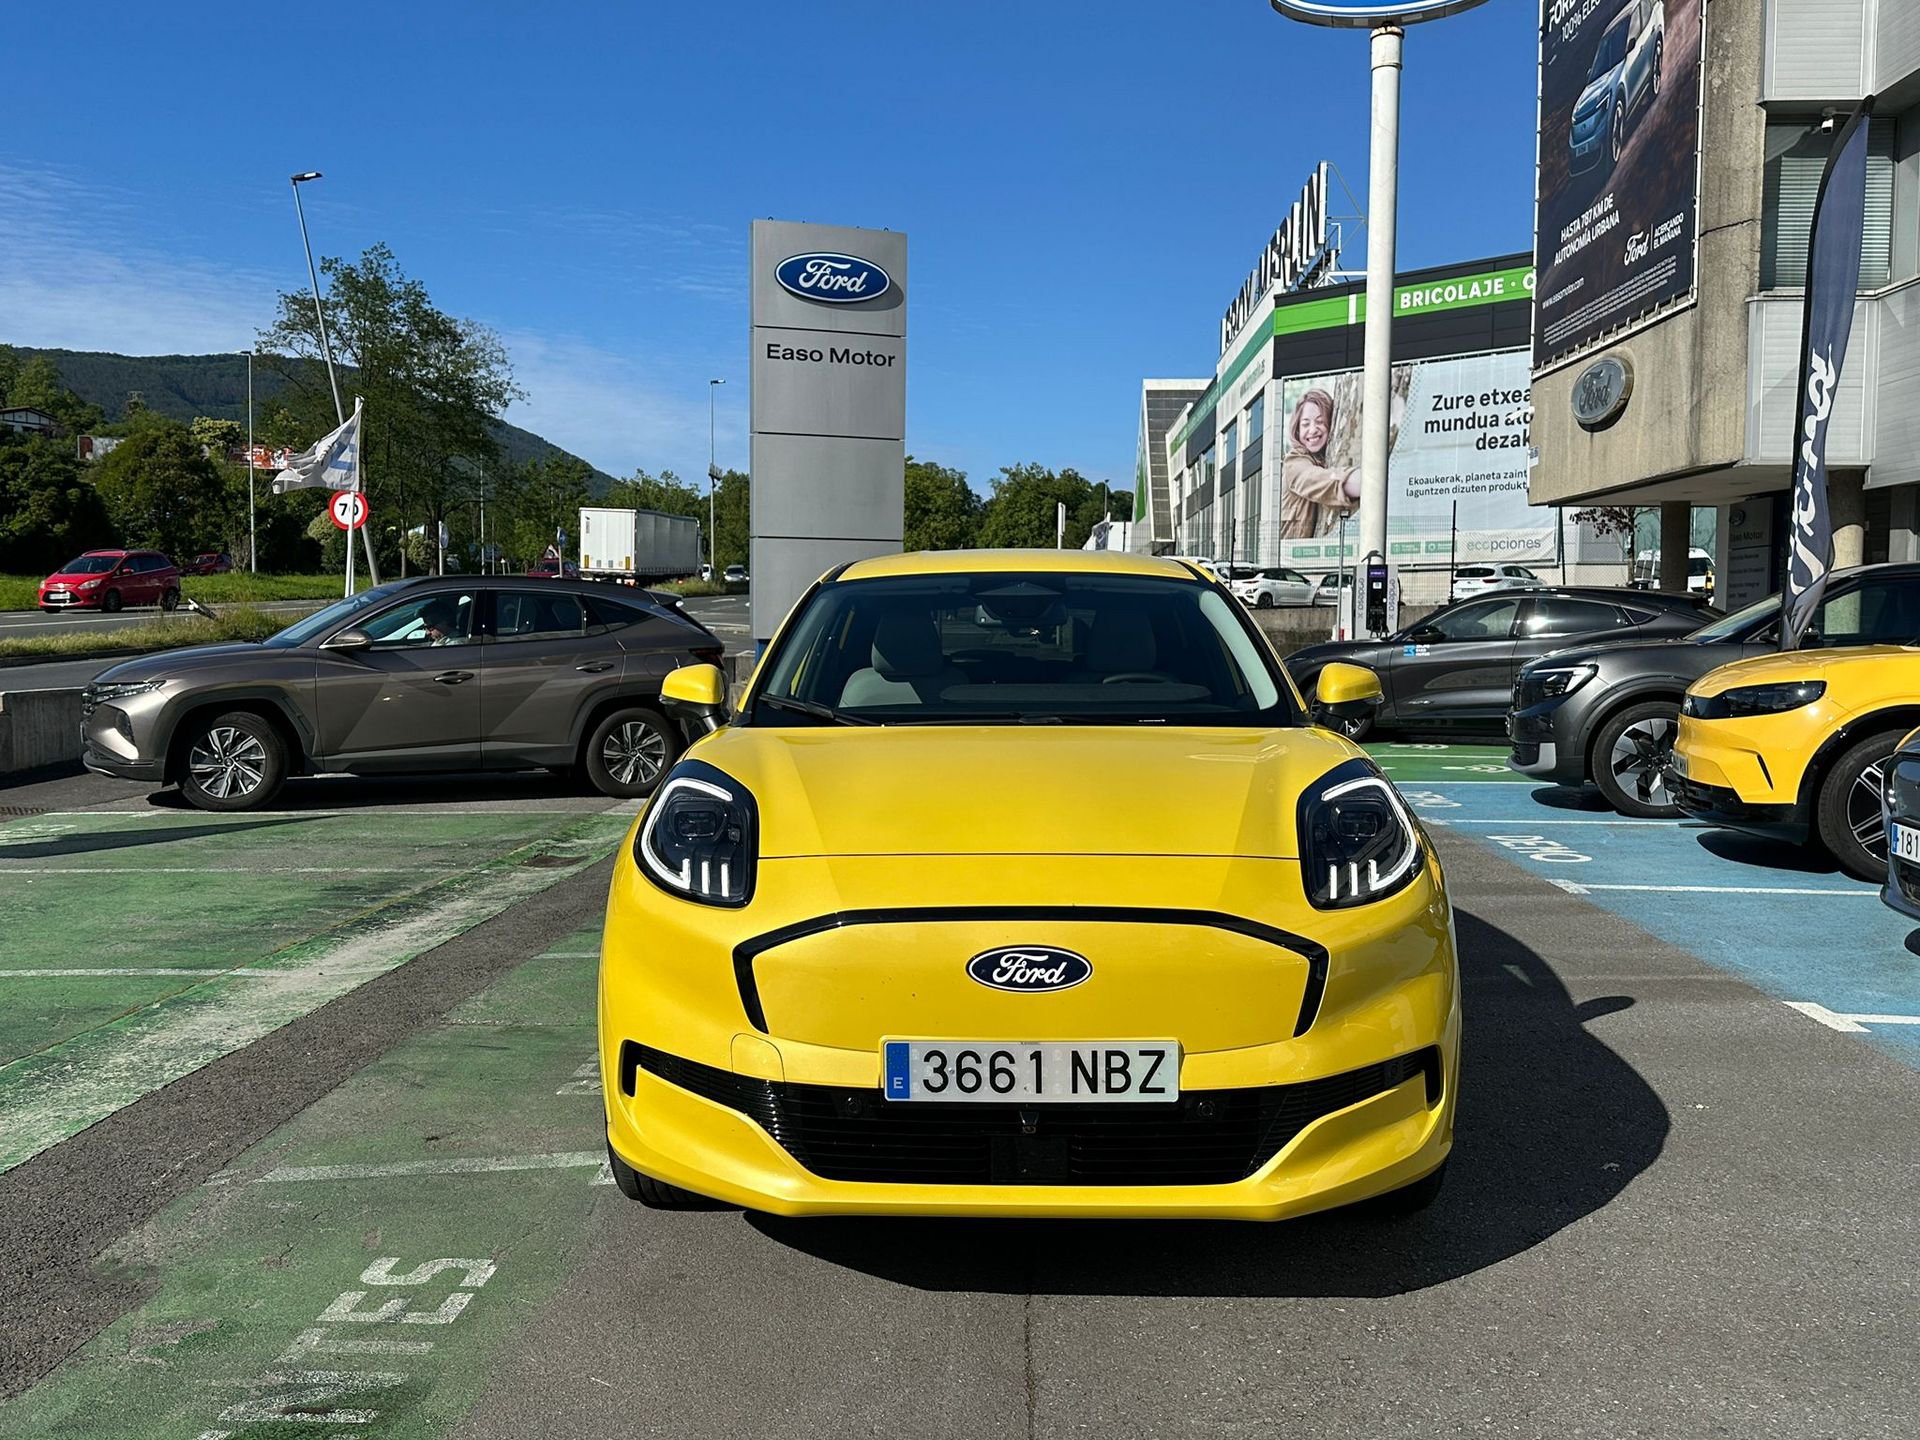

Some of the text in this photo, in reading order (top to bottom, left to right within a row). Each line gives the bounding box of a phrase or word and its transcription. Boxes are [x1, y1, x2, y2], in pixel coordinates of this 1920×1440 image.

[1562, 10, 1582, 42] 100%
[1560, 192, 1614, 243] HASTA 787 KM DE
[1554, 209, 1620, 267] AUTONOMÍA URBANA
[1624, 231, 1650, 266] Ford
[798, 259, 869, 293] Ford
[1400, 277, 1505, 309] BRICOLAJE
[767, 343, 896, 367] Easo Motor
[1432, 394, 1475, 412] Zure
[1424, 411, 1500, 434] mundua
[1406, 486, 1450, 498] laguntzen
[1451, 483, 1487, 494] dizuten
[1408, 473, 1464, 487] Ekoaukerak,
[1465, 470, 1501, 484] planeta
[1486, 835, 1593, 863] DEMO
[1901, 830, 1919, 858] 181
[992, 953, 1068, 984] Ford
[893, 1077, 904, 1089] E
[922, 1050, 1166, 1094] 3661 NBZ
